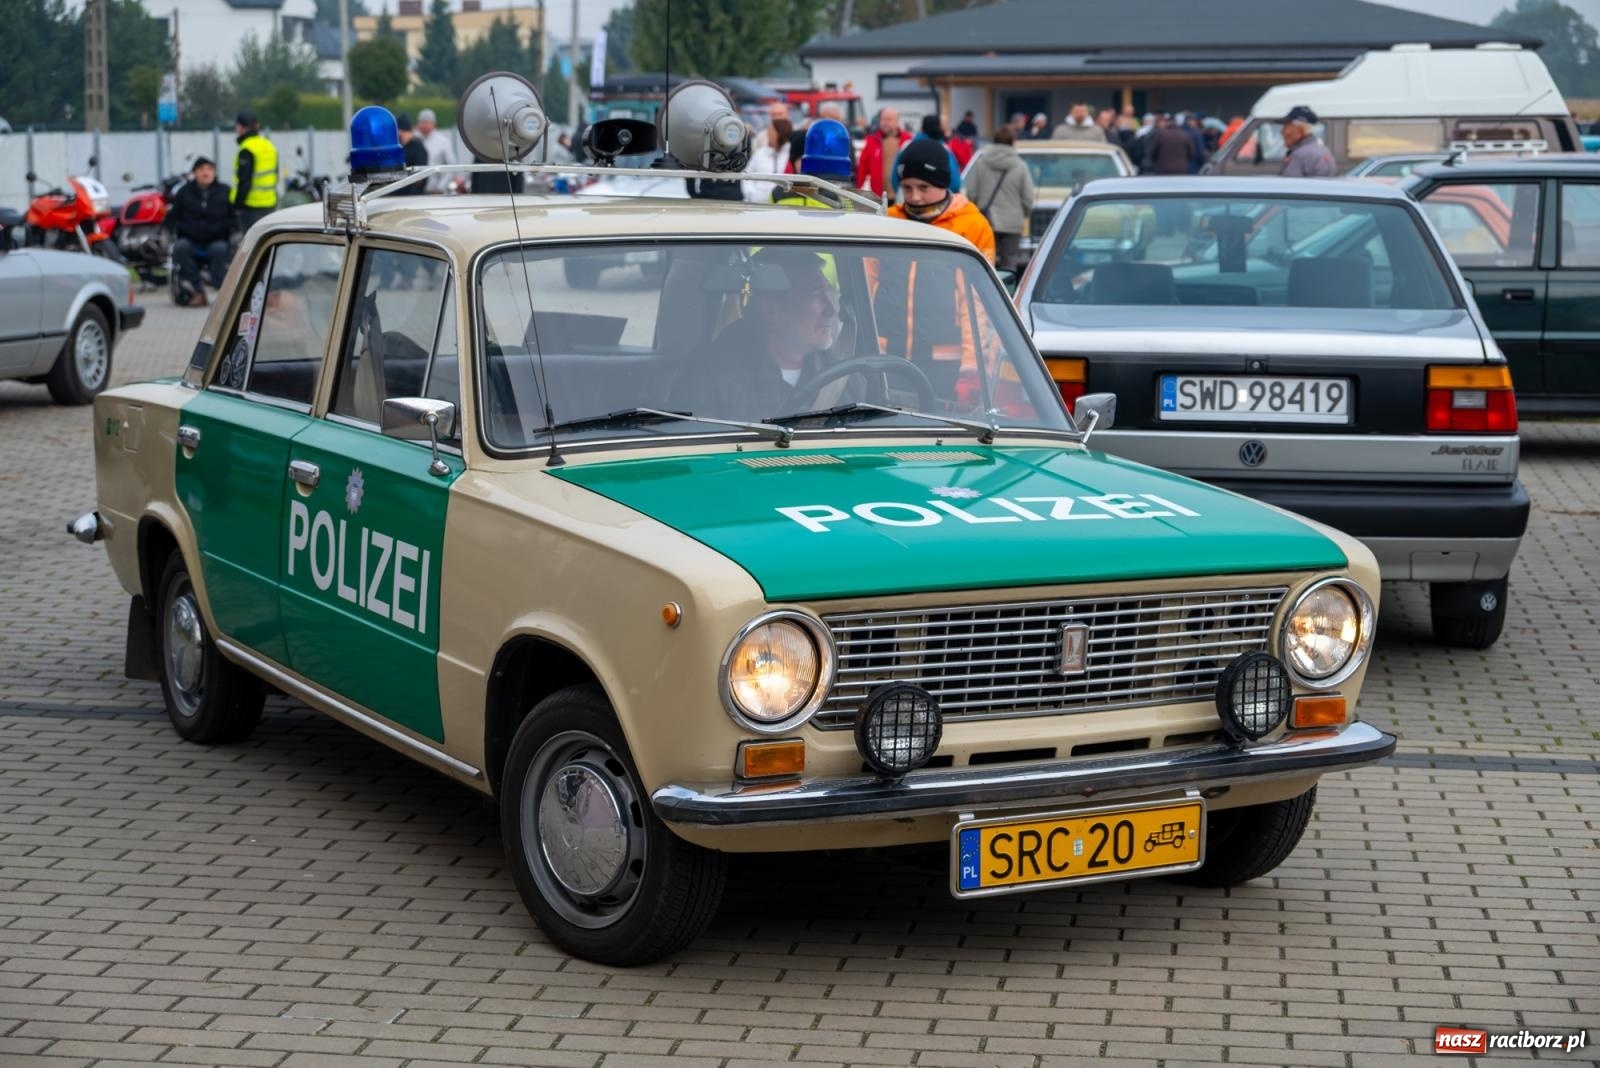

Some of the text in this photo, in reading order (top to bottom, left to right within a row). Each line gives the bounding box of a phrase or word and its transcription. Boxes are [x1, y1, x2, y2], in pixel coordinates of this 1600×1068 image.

[1163, 398, 1175, 408] PL
[1179, 380, 1344, 413] SWD 98419
[1431, 445, 1504, 456] Jetta
[774, 493, 1202, 533] POLIZEI
[288, 499, 431, 634] POLIZEI
[989, 820, 1135, 880] SRC 20
[963, 866, 978, 879] PL
